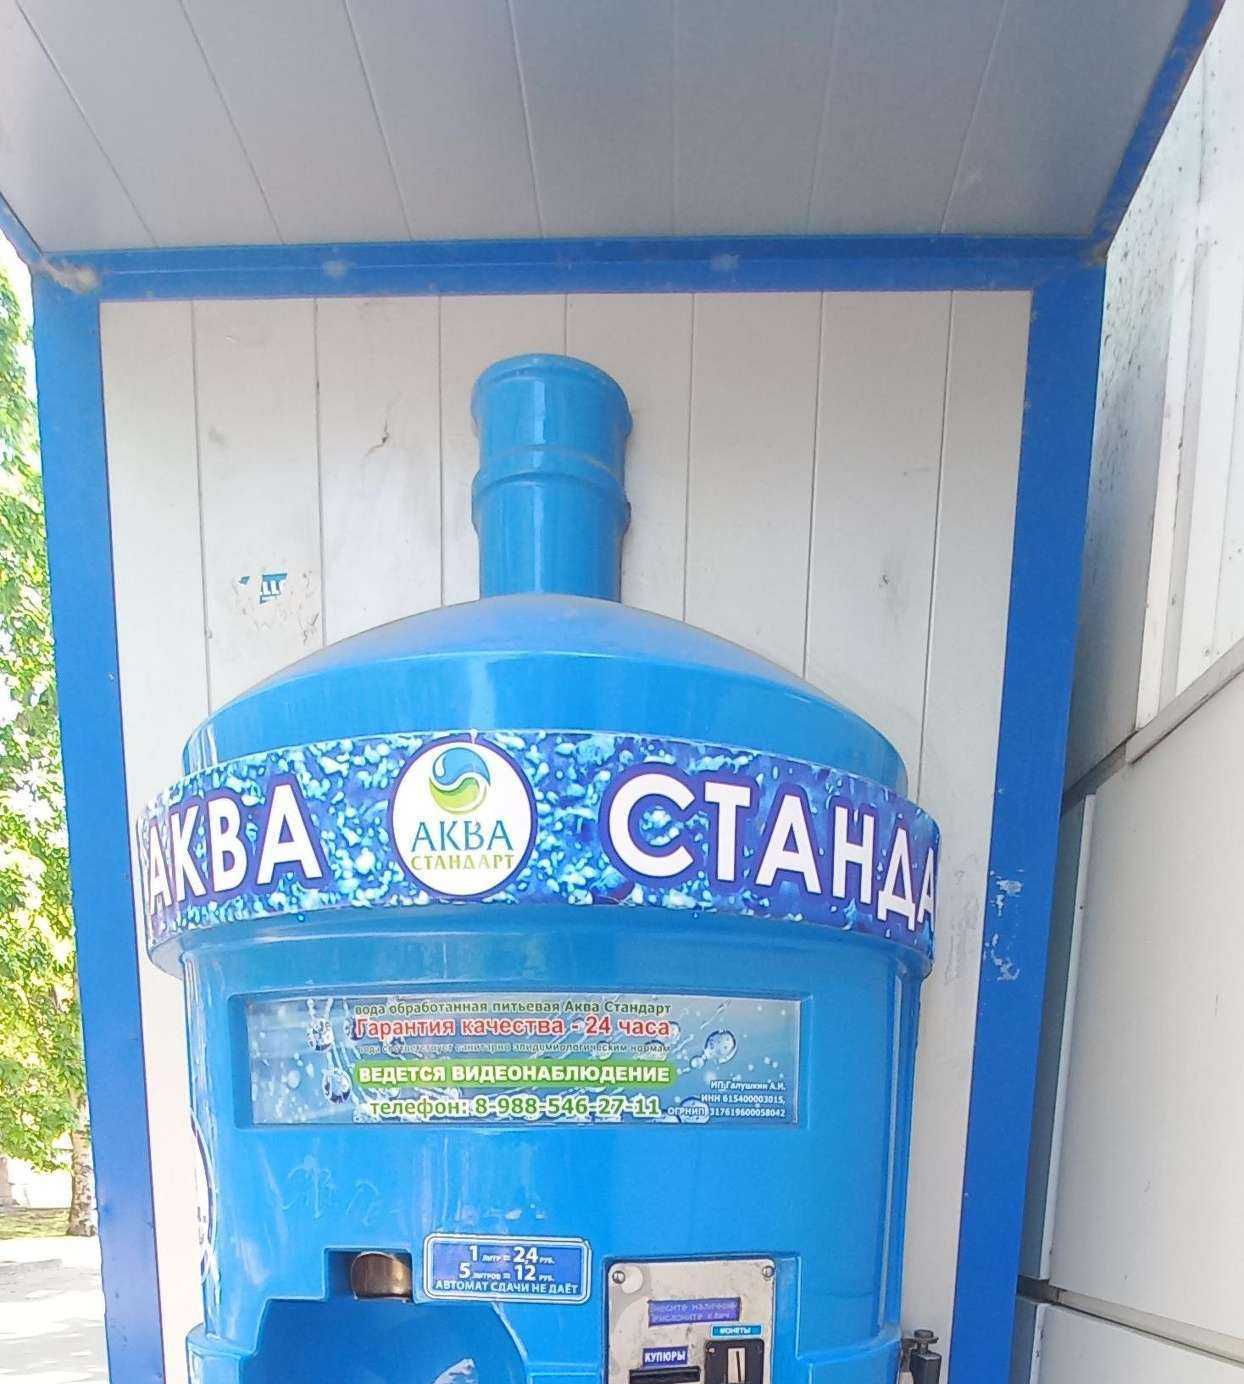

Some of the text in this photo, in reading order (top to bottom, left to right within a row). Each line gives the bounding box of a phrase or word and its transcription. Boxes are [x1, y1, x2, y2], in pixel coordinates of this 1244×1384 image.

[411, 820, 514, 852] АКВА
[149, 783, 323, 916] АКВА
[411, 854, 515, 871] СТАНДАРТ
[355, 1000, 671, 1016] вода обработанная питьевая Аква Стандарт
[356, 1018, 455, 1039] Гарантия
[461, 1018, 564, 1035] качества
[585, 1016, 611, 1034] 24
[619, 1020, 670, 1035] часа
[359, 1065, 671, 1083] ВЕДЕТСЯ ВИДЕОНАБЛЮДЕНИЕ
[370, 1098, 659, 1117] телефон: 8-988-546-27-11
[470, 1246, 478, 1261] 1
[459, 1262, 471, 1279] 5
[514, 1264, 536, 1281] 12
[435, 1280, 578, 1294] АВТОМАТ СДАЧИ НЕ ДАЁТ
[719, 1326, 751, 1335] МОНЕТЫ
[644, 1351, 686, 1363] КУПЮРЫ
